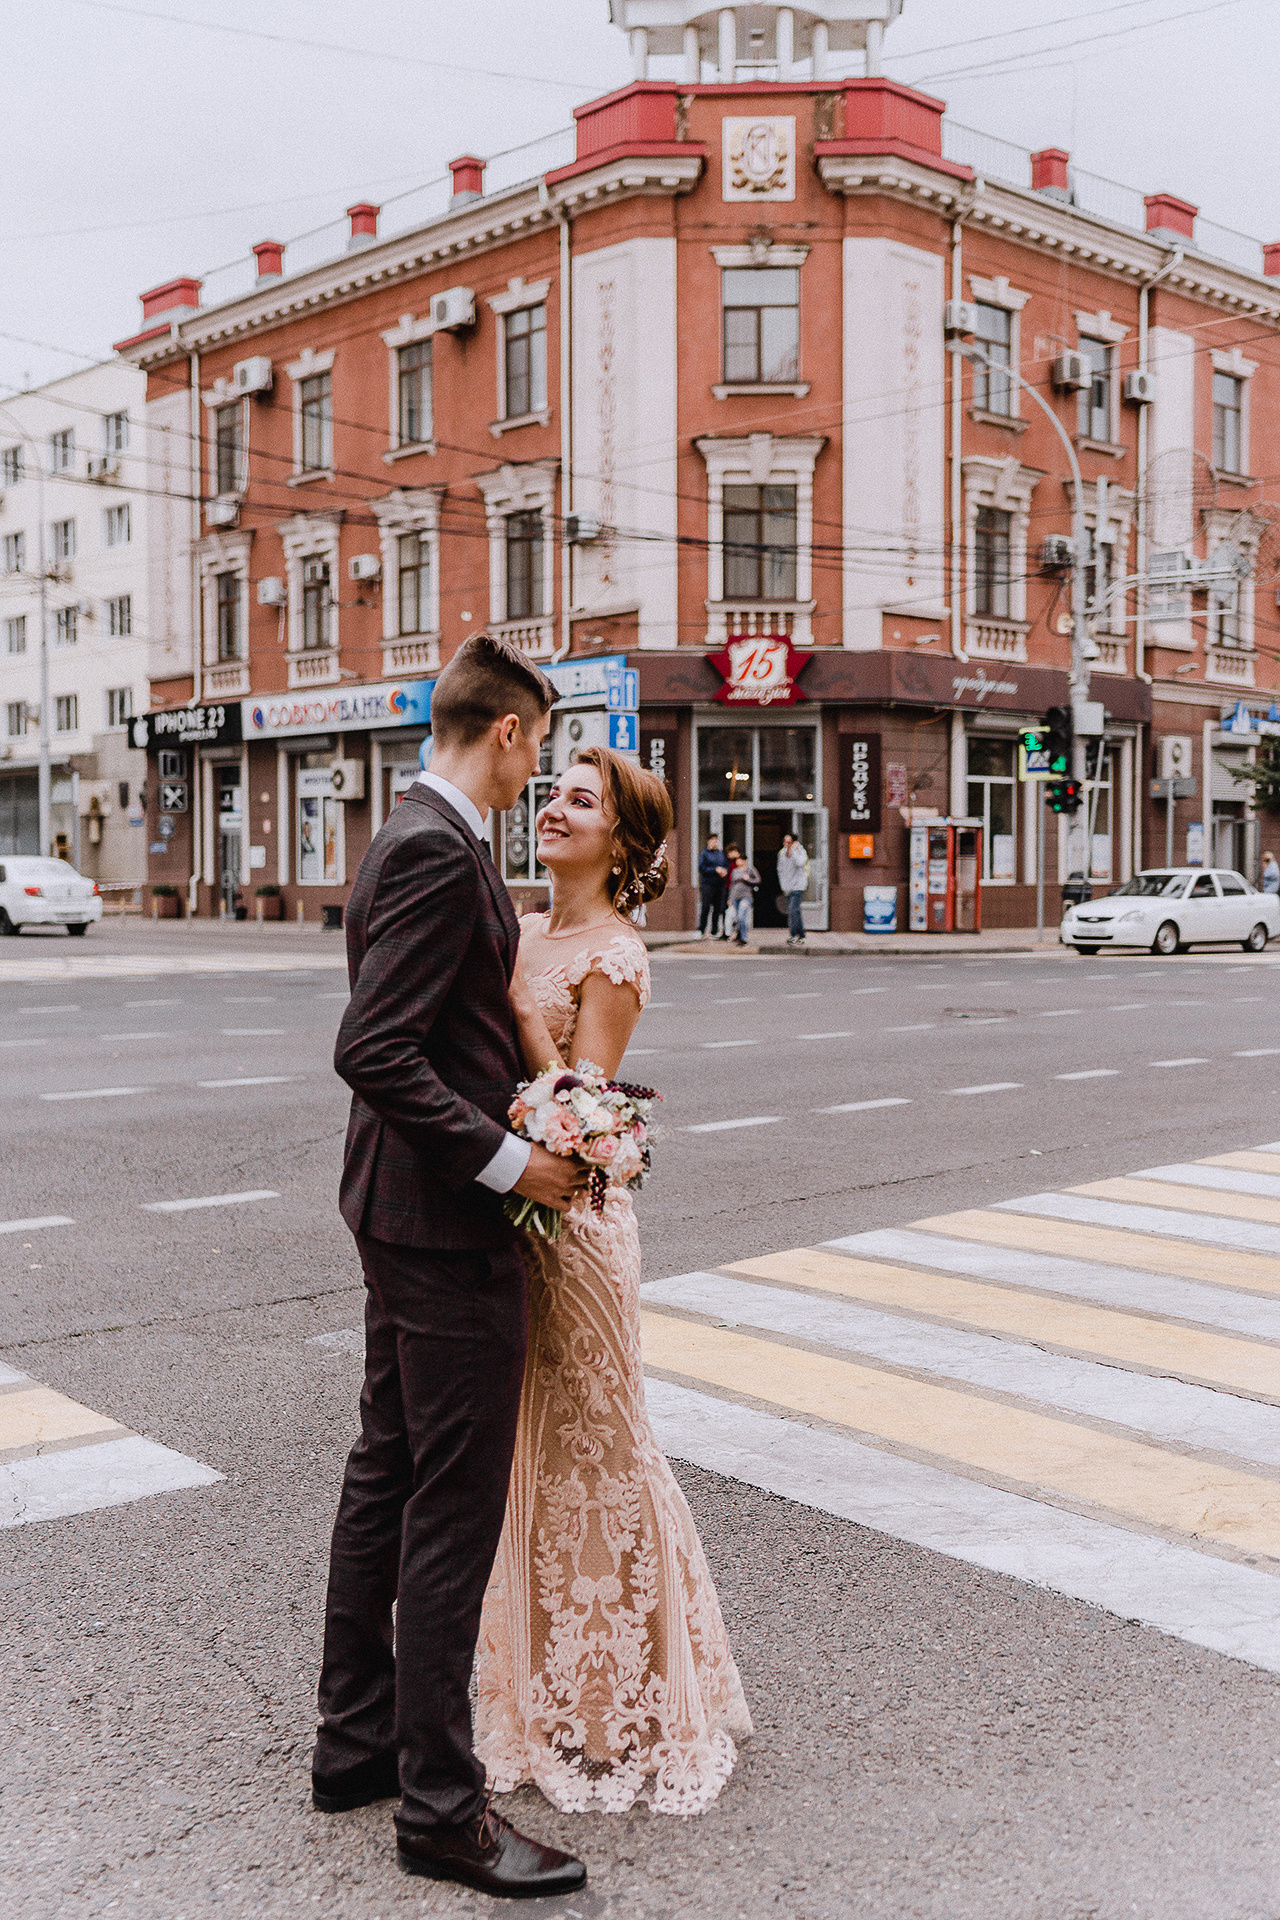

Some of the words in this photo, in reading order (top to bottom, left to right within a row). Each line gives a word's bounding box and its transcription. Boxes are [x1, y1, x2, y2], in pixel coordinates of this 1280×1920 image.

[737, 647, 780, 681] 15
[154, 707, 206, 735] IPHONE
[207, 705, 225, 729] 23
[267, 695, 386, 728] СОВКОМБАНК
[850, 741, 870, 820] ПРОДУКТЫ
